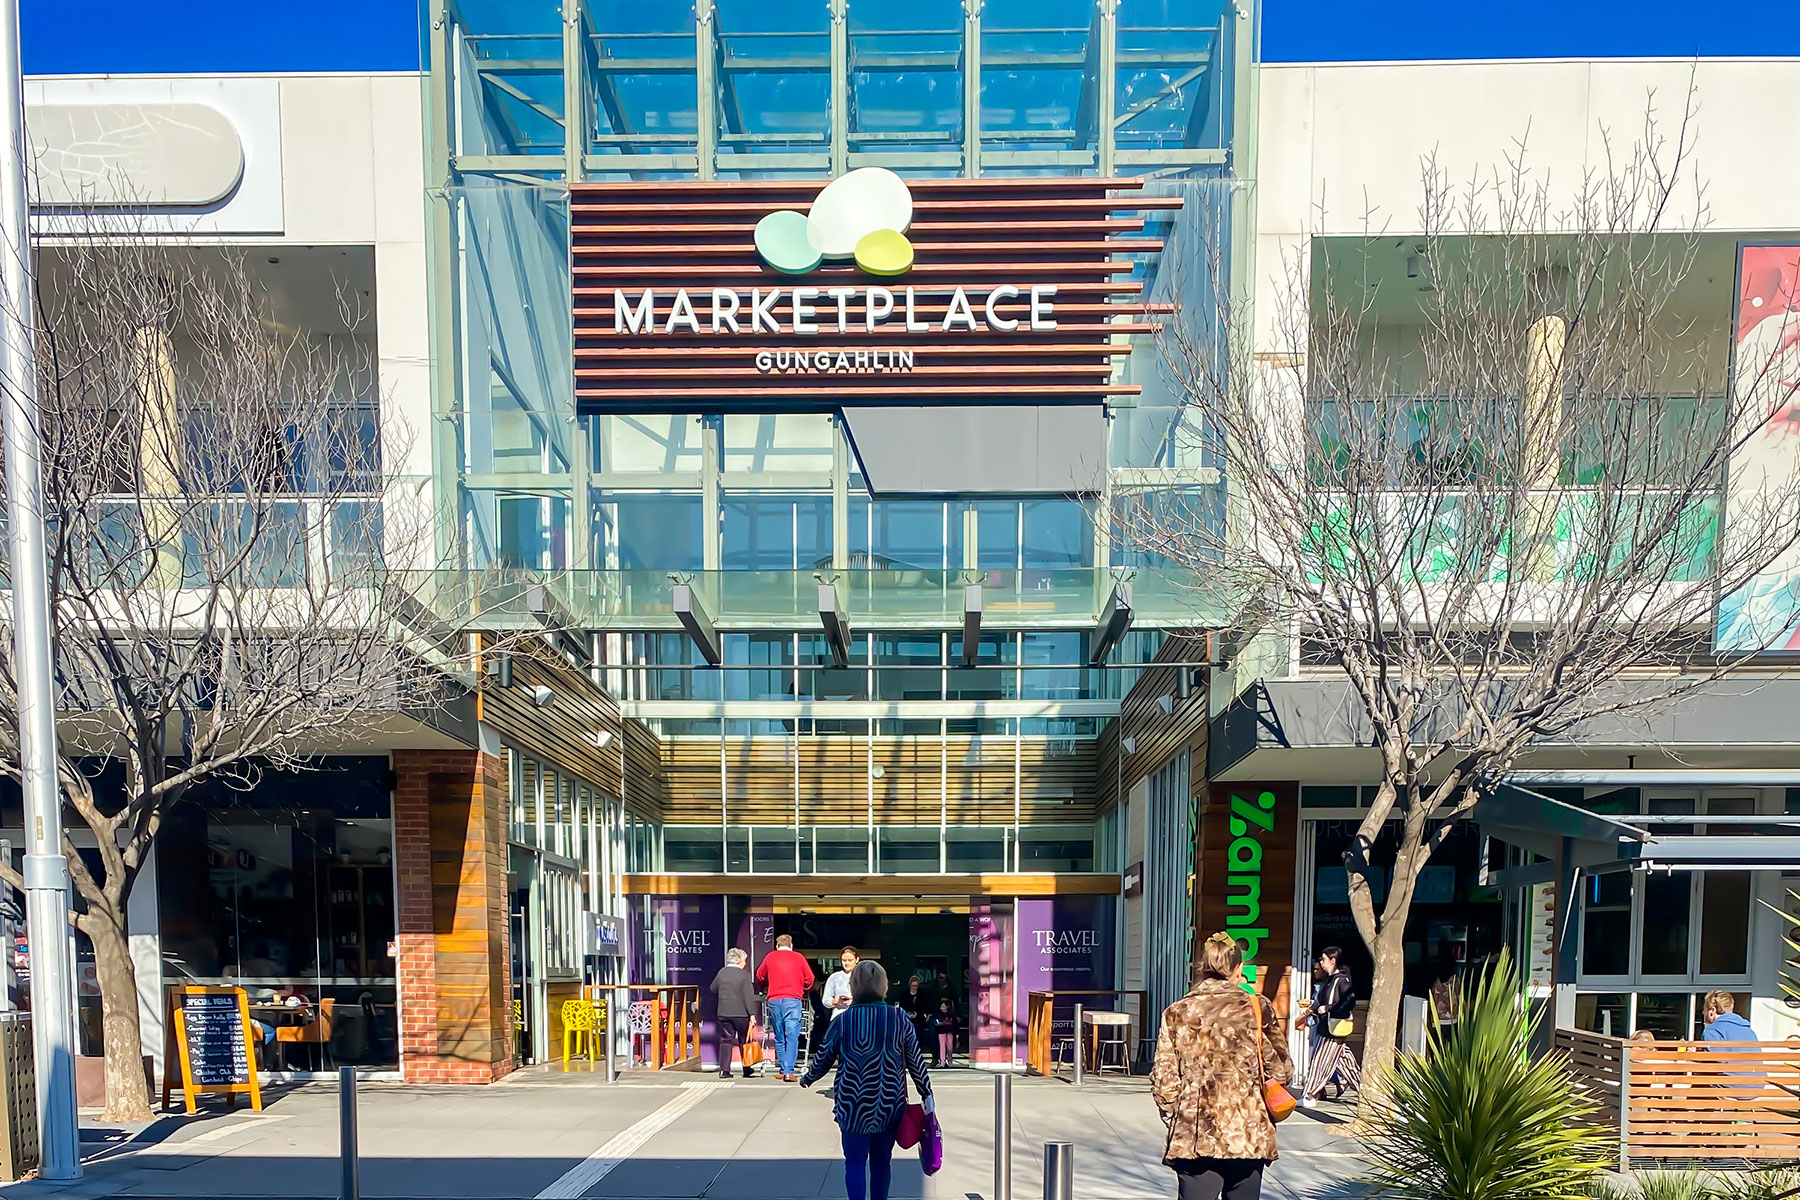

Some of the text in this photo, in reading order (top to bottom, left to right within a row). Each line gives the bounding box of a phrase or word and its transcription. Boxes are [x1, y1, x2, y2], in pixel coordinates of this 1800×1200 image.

[614, 285, 1058, 335] MARKETPLACE
[755, 350, 914, 371] GUNGAHLIN
[1032, 930, 1100, 946] TRAVEL
[652, 946, 703, 954] SOCIATES
[1040, 946, 1092, 954] ASSOCIATES
